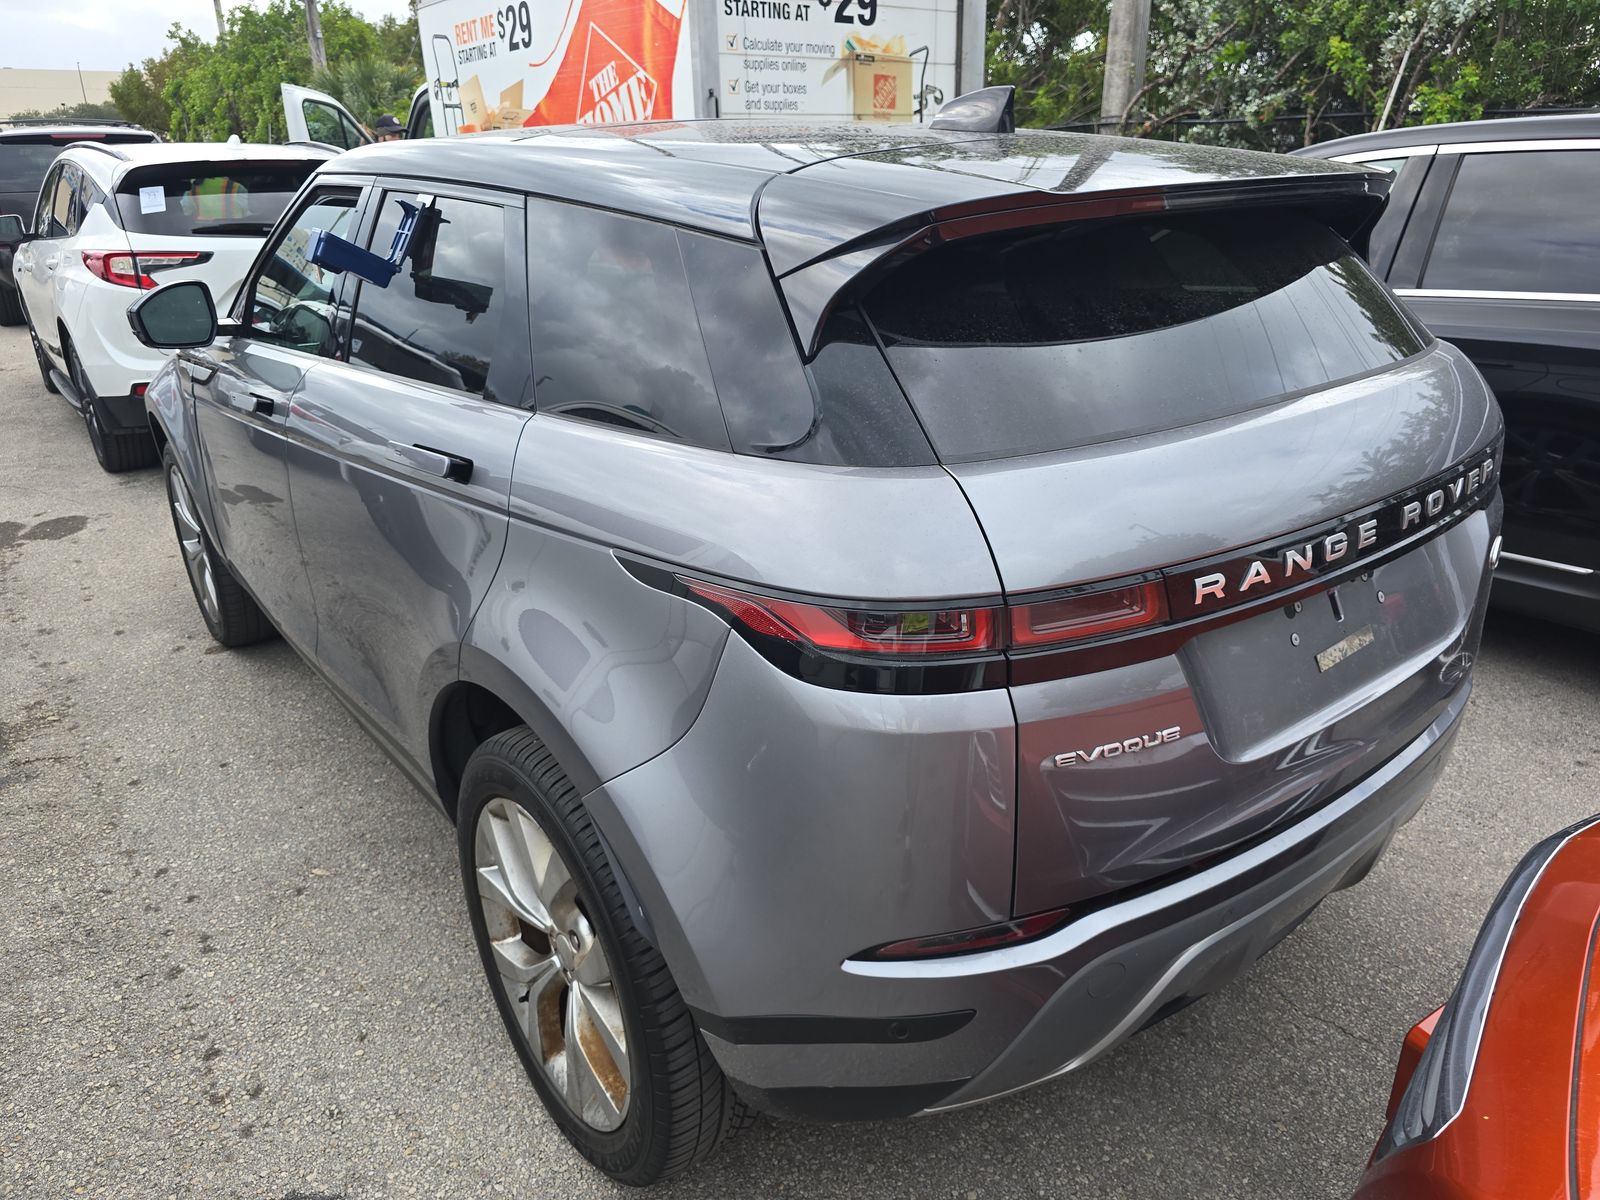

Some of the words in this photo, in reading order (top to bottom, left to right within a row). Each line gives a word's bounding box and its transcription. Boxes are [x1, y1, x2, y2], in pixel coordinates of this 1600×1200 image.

[724, 0, 791, 20] STARTING
[795, 4, 811, 22] AT
[454, 18, 478, 46] RENT
[480, 14, 496, 39] ME
[497, 0, 532, 52] $29
[458, 43, 488, 65] STARTING
[489, 41, 497, 58] AT
[743, 36, 783, 52] Calculate
[785, 43, 804, 55] your
[805, 43, 836, 58] moving
[743, 59, 780, 72] supplies
[781, 60, 808, 72] online
[588, 60, 620, 103] THE
[744, 80, 760, 93] Get
[761, 83, 780, 97] your
[782, 82, 808, 95] boxes
[745, 99, 761, 110] and
[763, 100, 799, 113] supplies
[1194, 519, 1378, 605] RANGE
[1401, 458, 1495, 530] ROVER
[1054, 726, 1181, 768] EVOQUE
